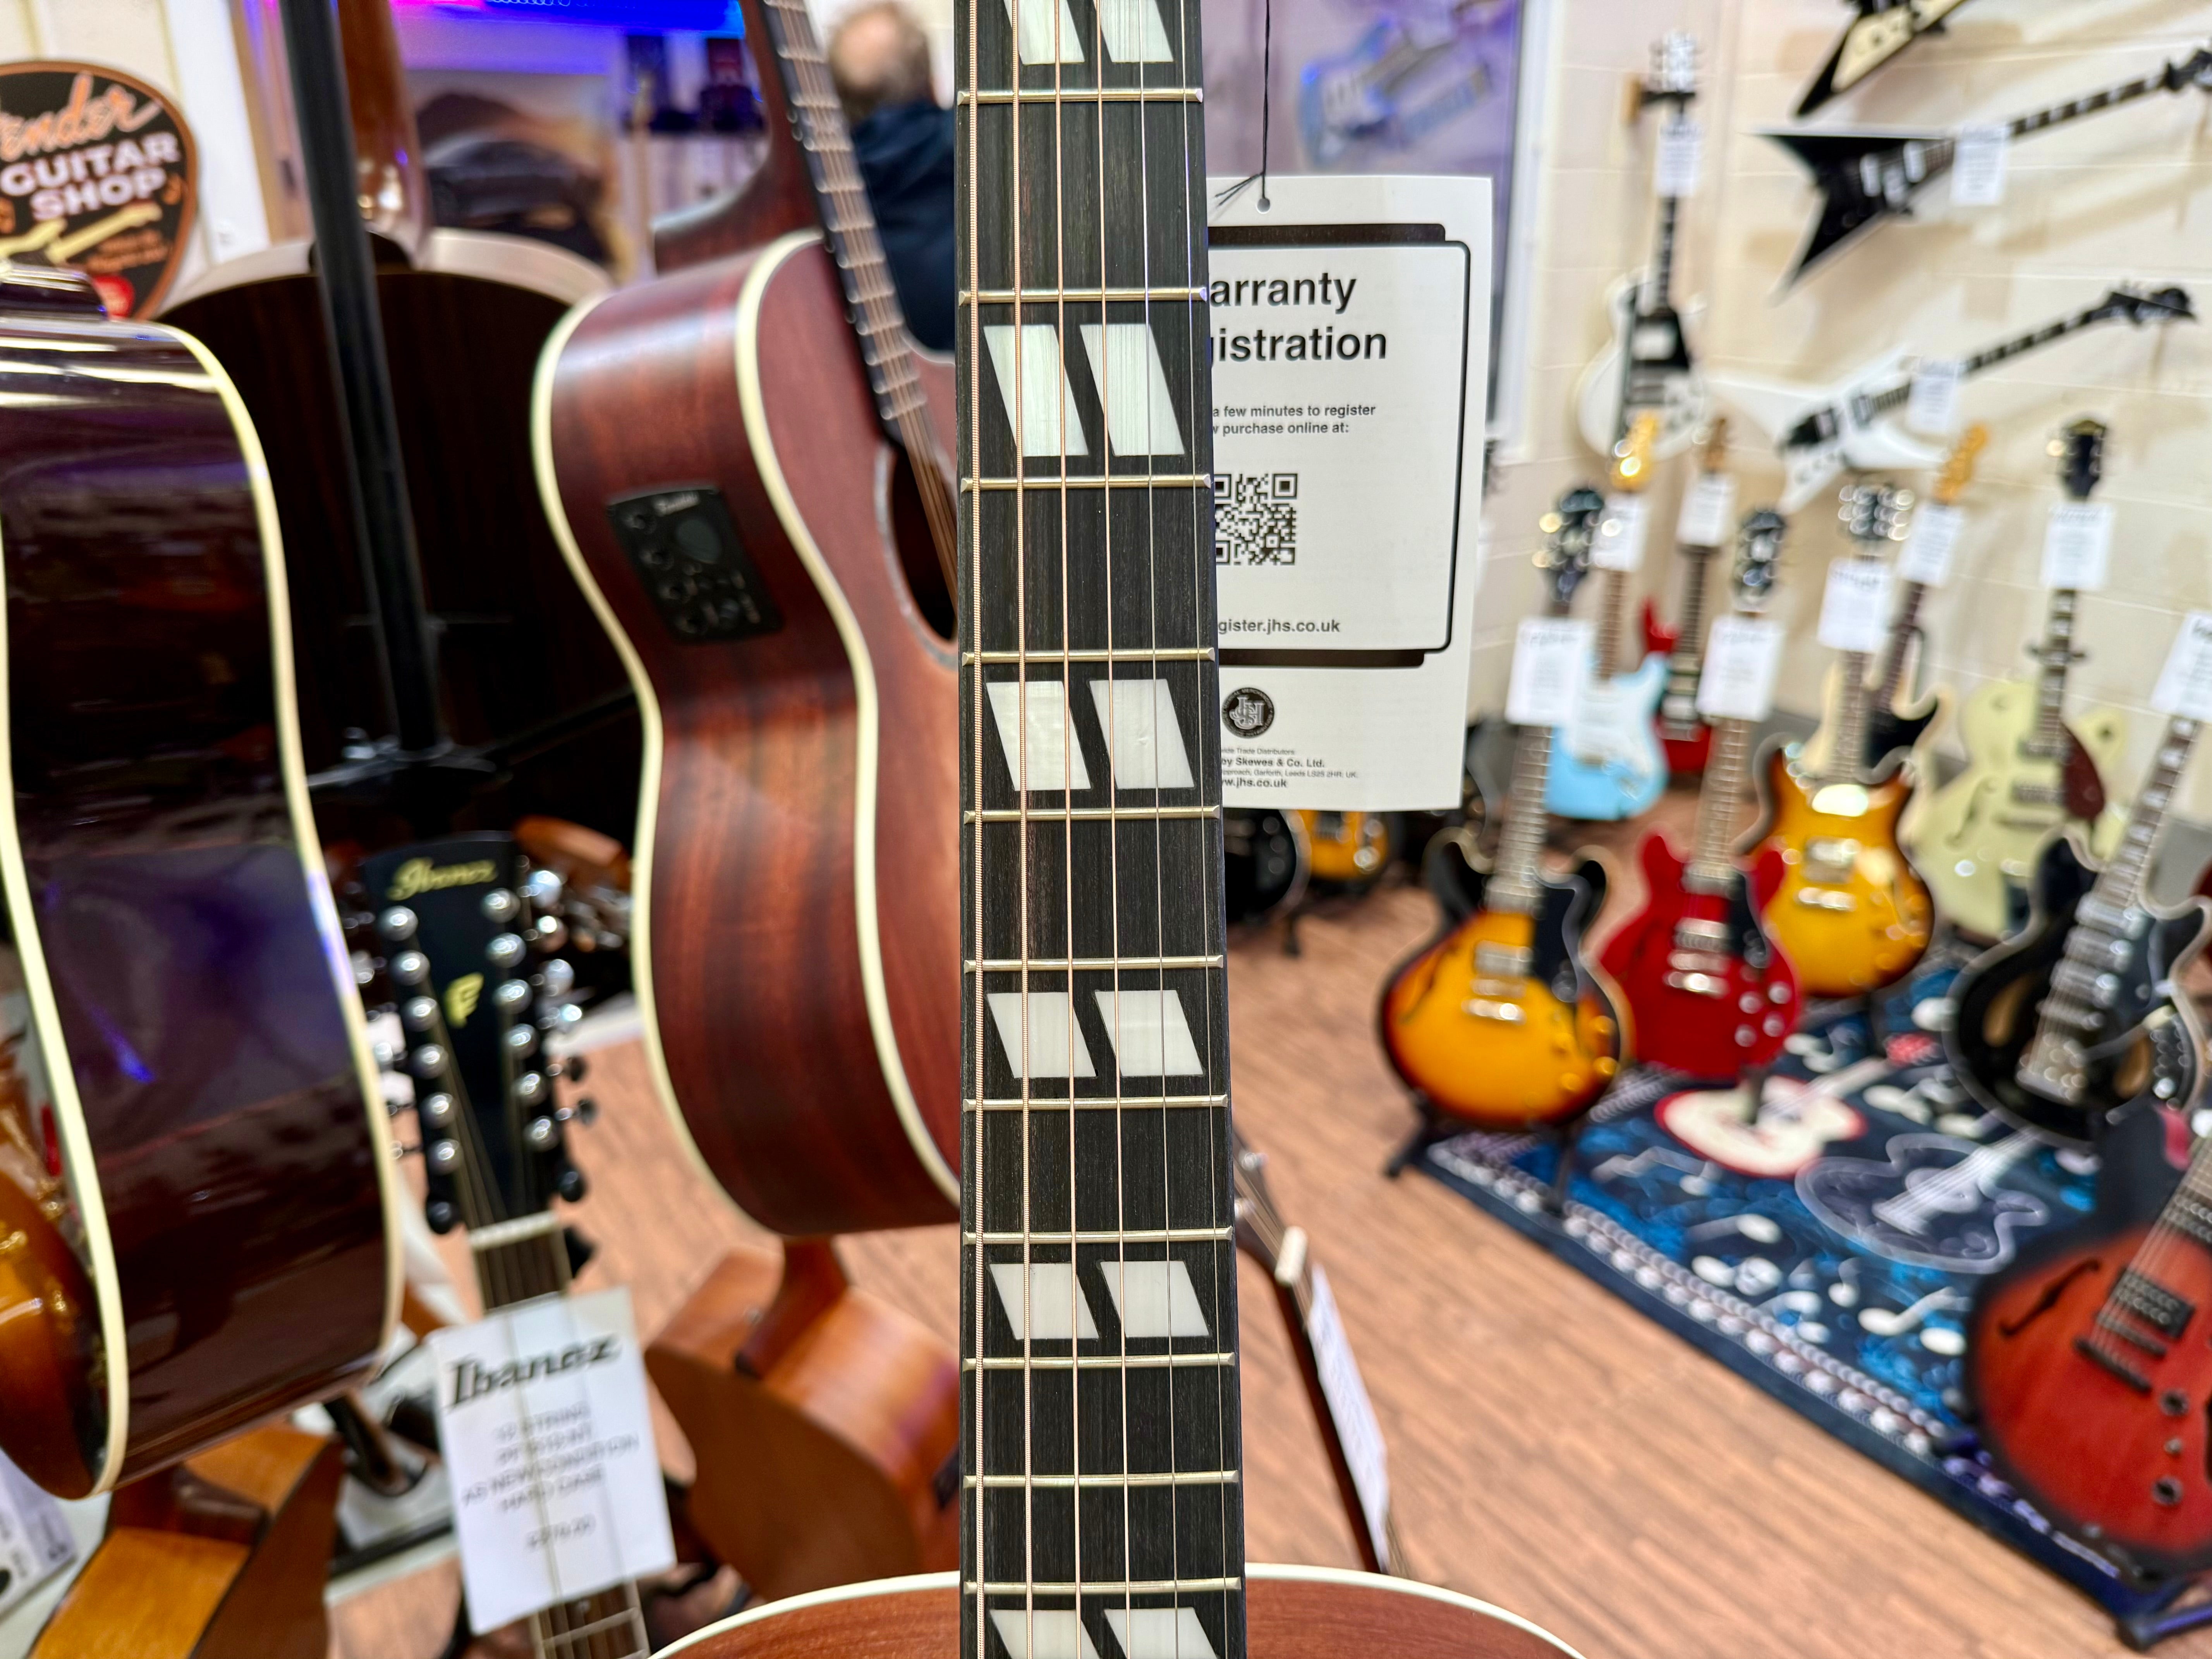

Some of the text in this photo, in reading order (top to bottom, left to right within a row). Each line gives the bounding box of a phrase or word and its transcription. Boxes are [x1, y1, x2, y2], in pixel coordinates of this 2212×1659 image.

[0, 70, 163, 161] ender
[0, 132, 180, 196] GUITAR
[30, 167, 167, 221] SHOP
[1210, 273, 1356, 314] arranty
[1213, 404, 1376, 418] a few minutes to register
[1223, 422, 1283, 436] purchase
[1288, 422, 1328, 434] online
[1332, 422, 1349, 433] at:
[1218, 619, 1341, 635] gister.jhs.co.uk
[1221, 757, 1325, 768] by Skewes & Co. Ltd.
[1222, 777, 1287, 788] w.jhs.co.uk
[445, 1333, 620, 1410] Ibanez
